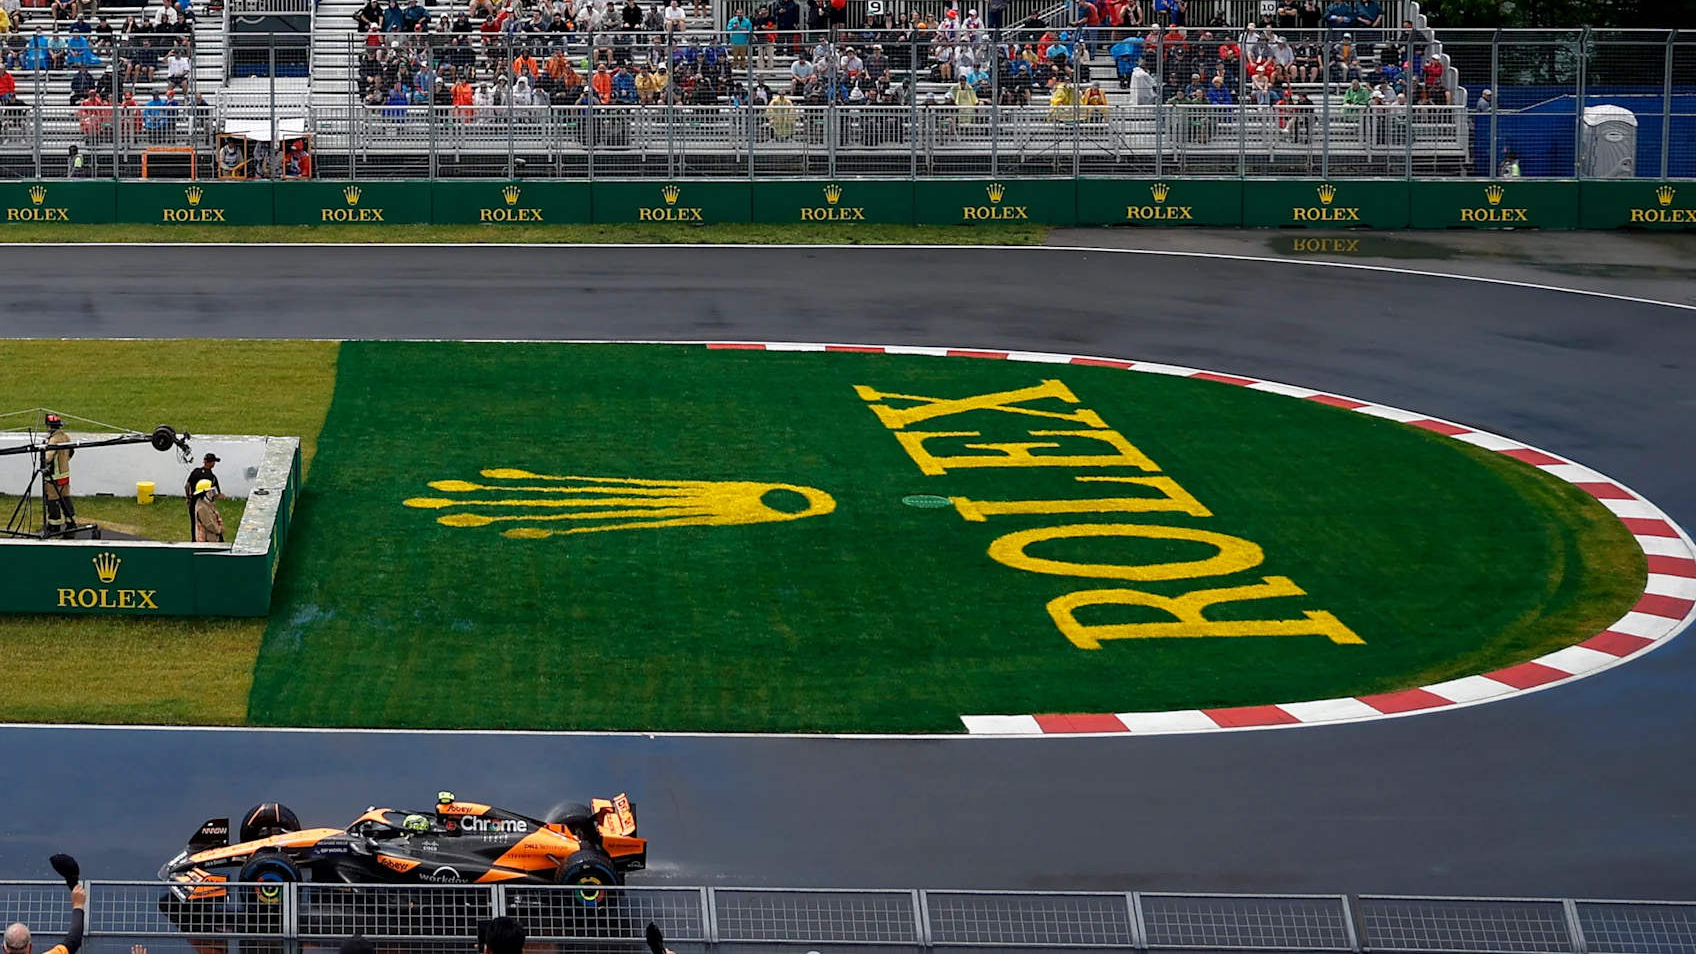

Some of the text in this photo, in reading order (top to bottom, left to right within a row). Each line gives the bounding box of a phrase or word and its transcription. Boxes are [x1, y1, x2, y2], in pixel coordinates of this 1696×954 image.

[870, 1, 882, 12] 9
[1261, 3, 1275, 12] 10
[7, 208, 69, 222] ROLEX
[163, 208, 225, 222] ROLEX
[322, 208, 384, 222] ROLEX
[480, 208, 543, 222] ROLEX
[639, 208, 703, 222] ROLEX
[801, 207, 864, 221] ROLEX
[964, 206, 1028, 220] ROLEX
[1127, 206, 1192, 220] ROLEX
[1294, 208, 1359, 222] ROLEX
[1461, 209, 1527, 222] ROLEX
[1630, 208, 1696, 223] ROLEX
[853, 379, 1368, 650] ROLEX
[57, 587, 158, 610] ROLEX
[460, 815, 528, 833] Chrome
